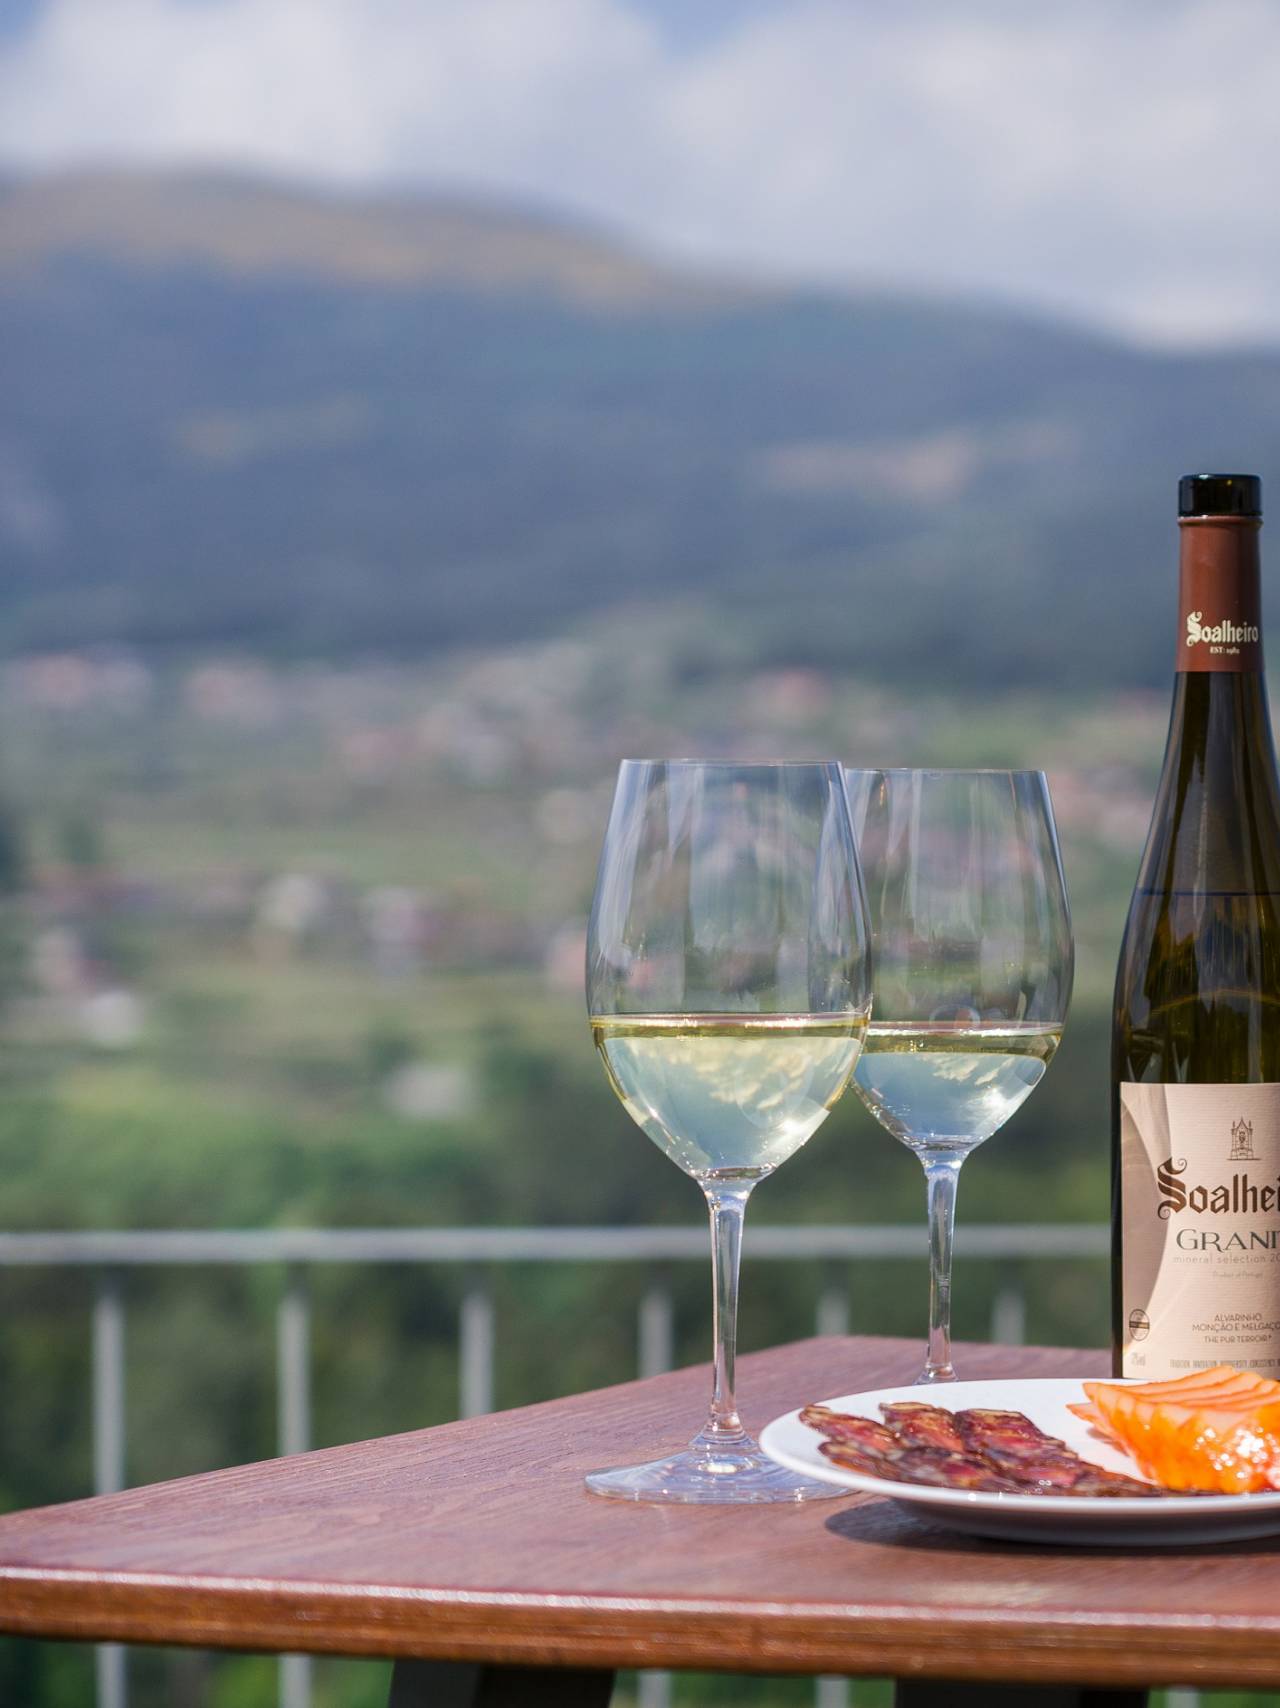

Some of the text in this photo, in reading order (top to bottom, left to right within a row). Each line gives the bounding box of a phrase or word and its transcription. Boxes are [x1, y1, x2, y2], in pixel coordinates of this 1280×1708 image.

[1186, 611, 1259, 647] Soalheiro
[1172, 1253, 1213, 1264] mineral
[1216, 1253, 1266, 1265] selection
[1213, 1312, 1263, 1322] ALVARINHO
[1234, 1323, 1241, 1332] E
[1204, 1335, 1220, 1344] THE
